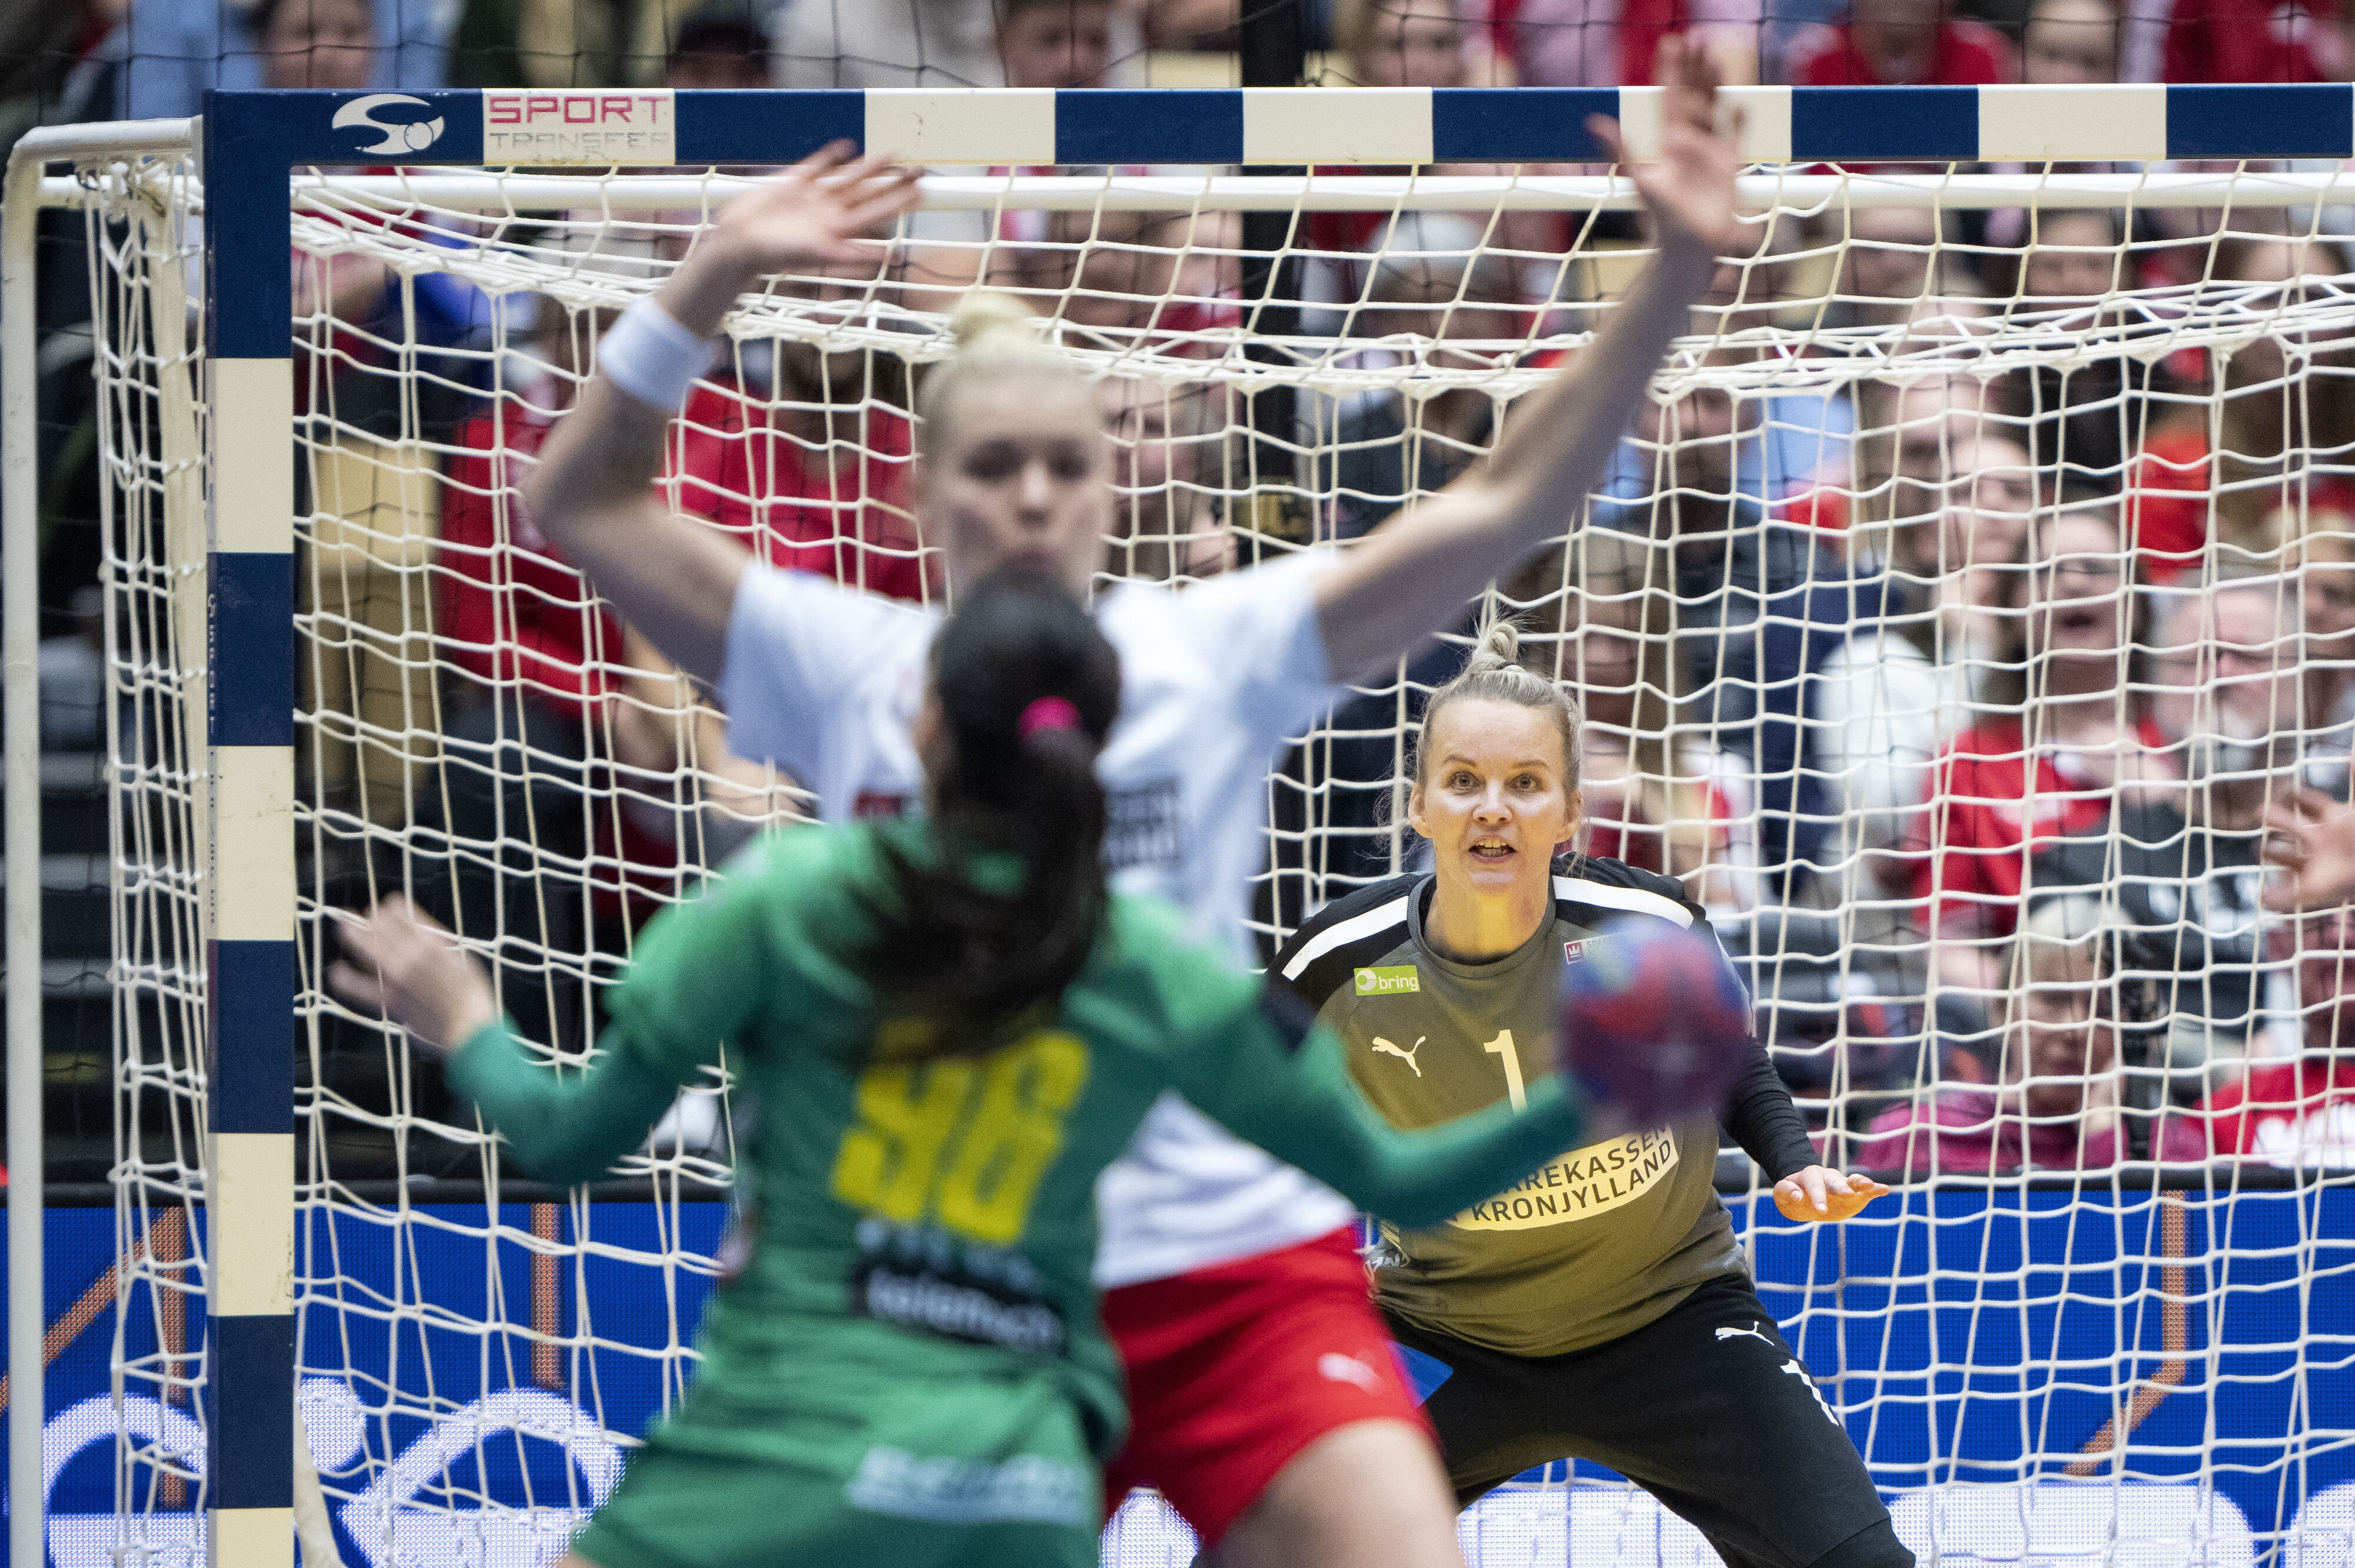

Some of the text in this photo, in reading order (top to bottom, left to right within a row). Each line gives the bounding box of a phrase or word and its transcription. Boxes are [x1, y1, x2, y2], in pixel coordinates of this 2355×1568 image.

[489, 97, 669, 123] SPORT
[489, 132, 669, 148] TRANSFER
[1378, 975, 1419, 991] bring
[1483, 1029, 1528, 1115] 1
[1472, 1139, 1671, 1222] KRONJYLLAND
